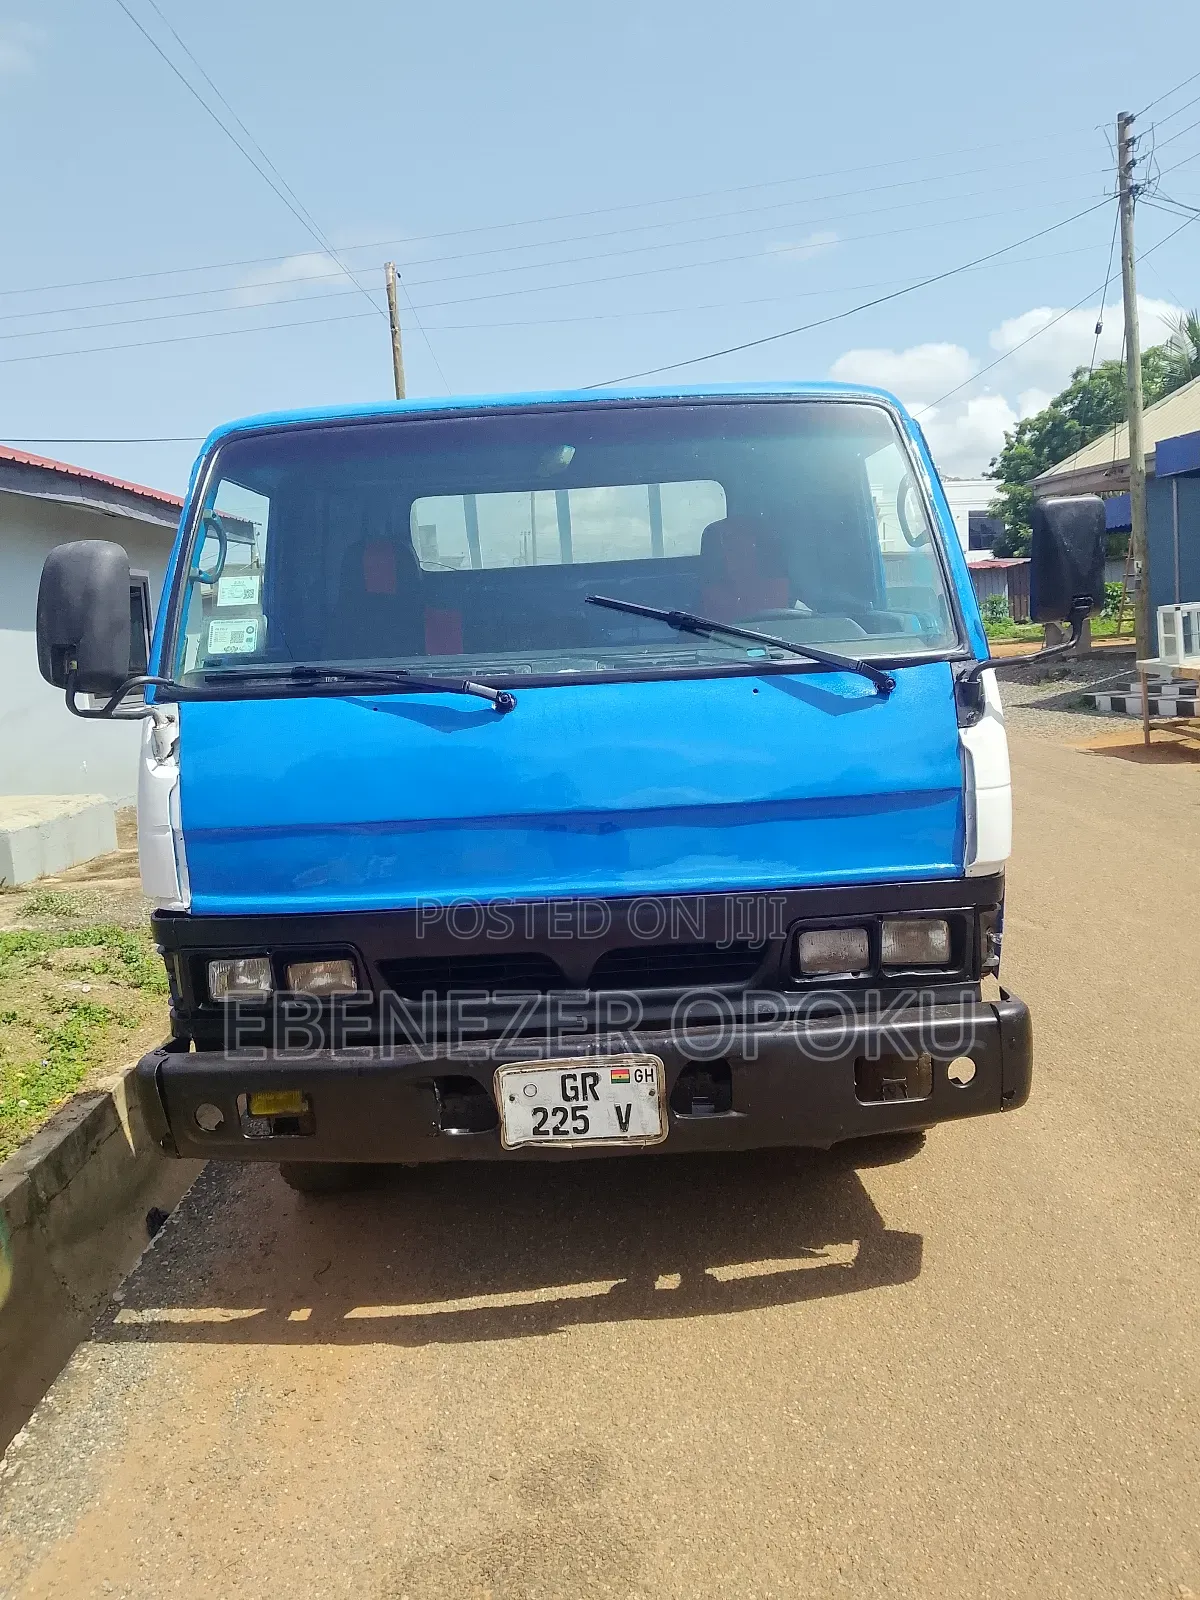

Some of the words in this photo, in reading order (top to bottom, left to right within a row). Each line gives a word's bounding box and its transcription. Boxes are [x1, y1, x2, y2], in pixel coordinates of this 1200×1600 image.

[561, 1072, 600, 1102] GR
[634, 1069, 654, 1083] GH
[532, 1105, 590, 1136] 225
[615, 1103, 632, 1132] V
